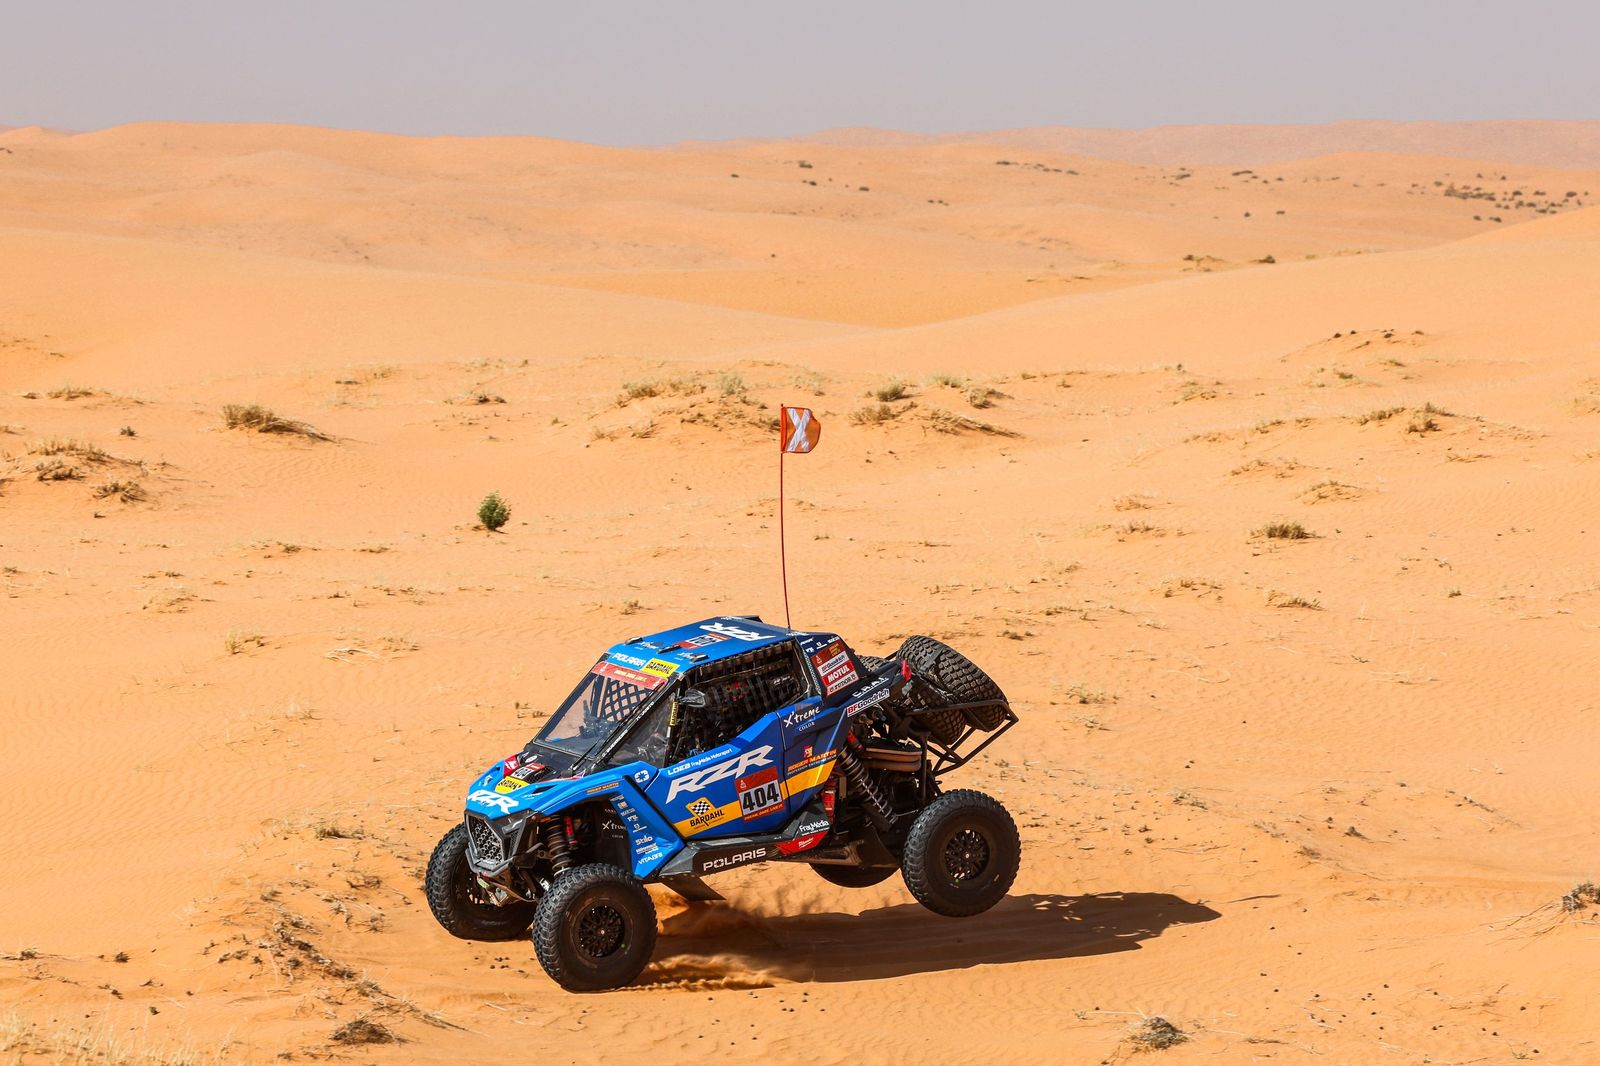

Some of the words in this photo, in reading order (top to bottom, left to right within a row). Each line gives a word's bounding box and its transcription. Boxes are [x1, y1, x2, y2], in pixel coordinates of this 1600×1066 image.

[699, 622, 777, 642] RZR
[612, 653, 646, 667] POLARIS
[646, 661, 674, 675] BARDAHL
[827, 665, 850, 683] MOTUL
[847, 688, 889, 713] BFGoodrich
[798, 721, 815, 731] COLOR
[667, 763, 691, 775] LOEB
[787, 758, 809, 771] ROGER
[809, 749, 837, 762] MARTIN
[665, 744, 774, 805] RZR
[466, 789, 519, 814] RZR
[742, 782, 779, 812] 404
[689, 809, 725, 827] BARDAHL
[703, 847, 767, 872] POLARIS
